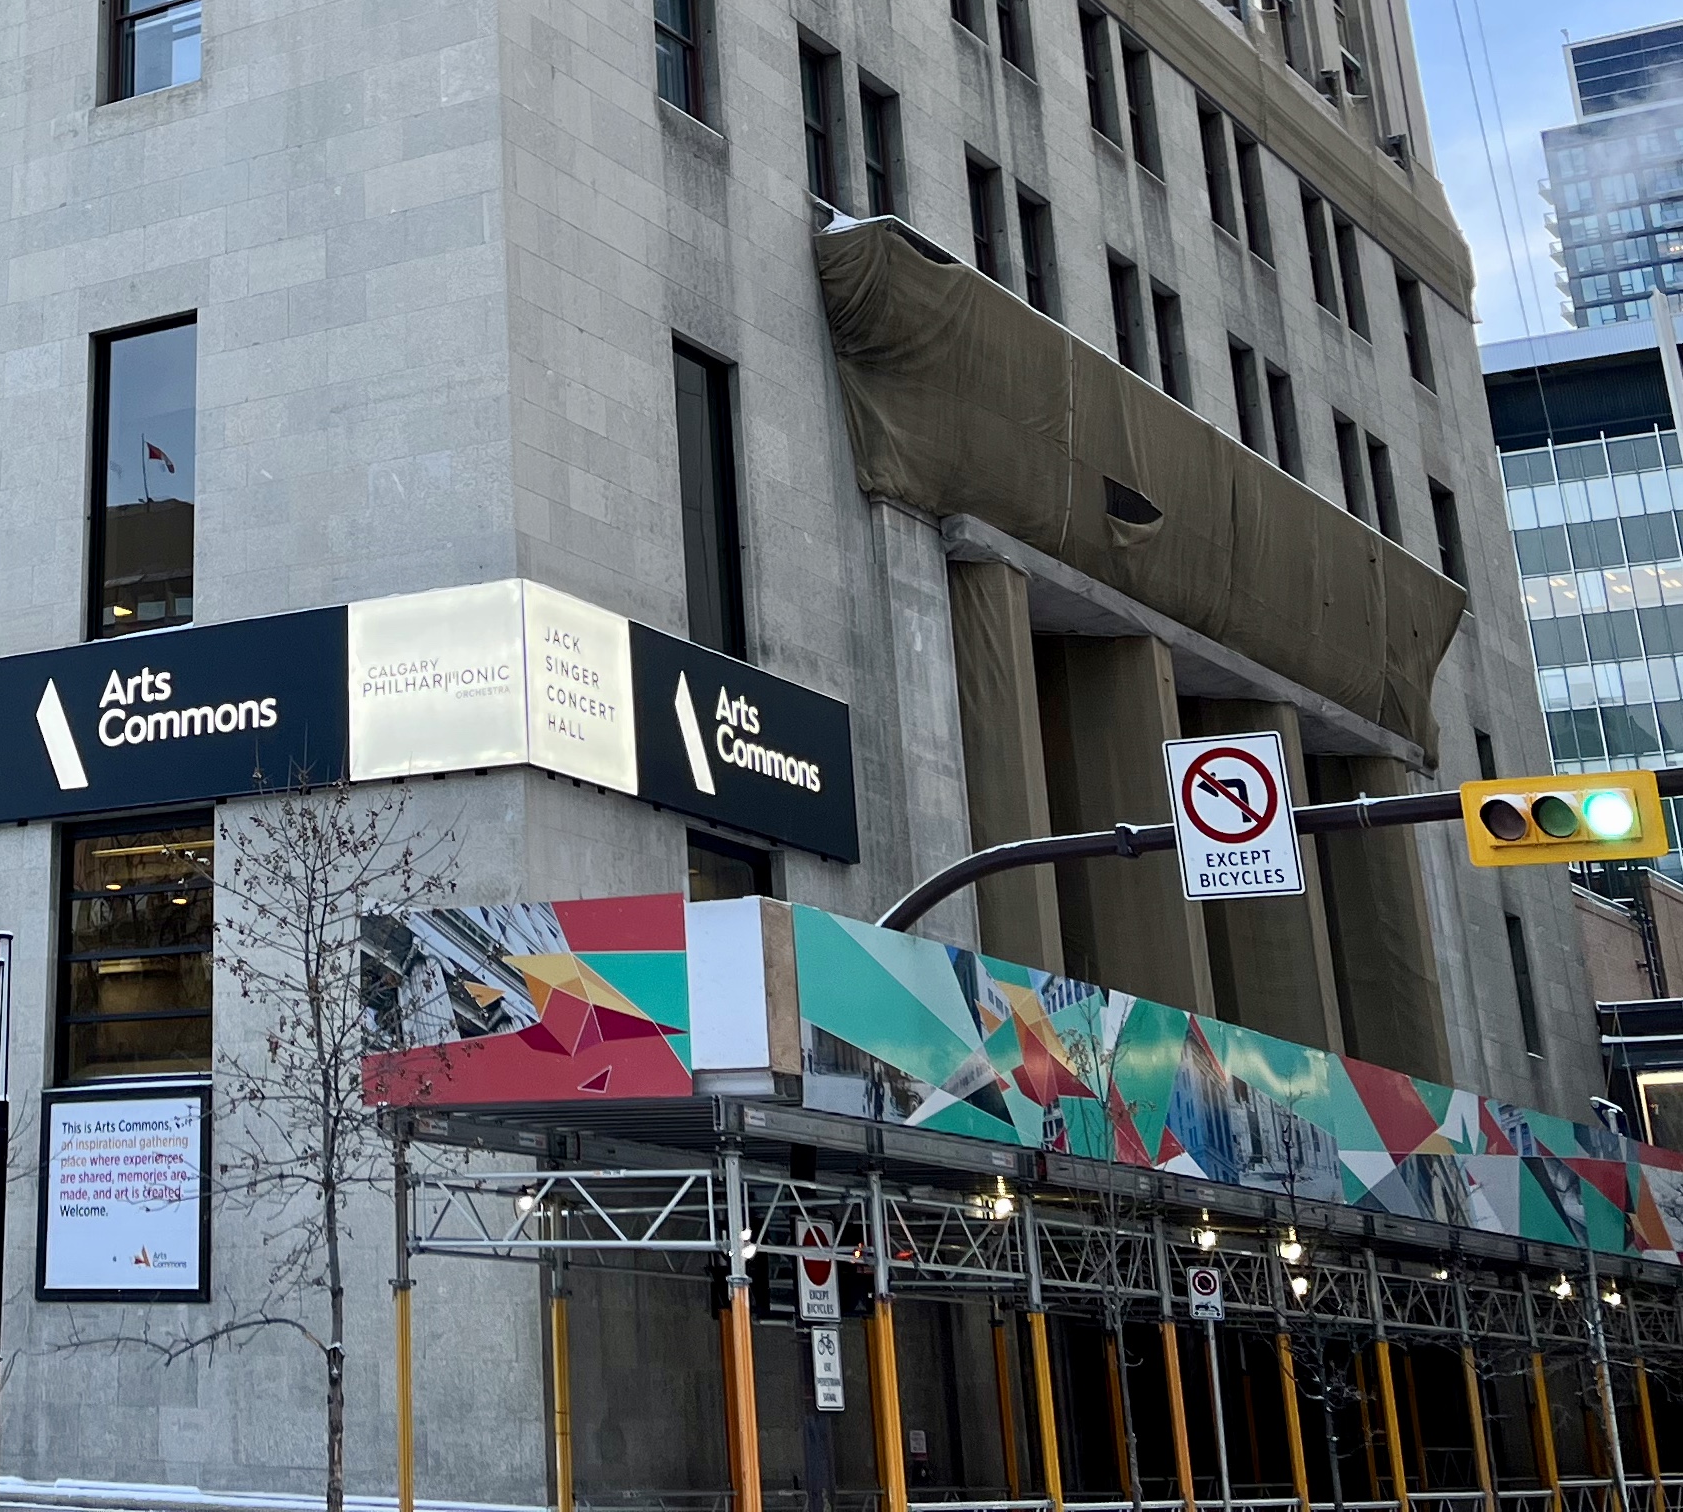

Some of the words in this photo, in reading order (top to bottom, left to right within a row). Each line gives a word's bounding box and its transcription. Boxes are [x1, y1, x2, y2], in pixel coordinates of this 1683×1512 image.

[543, 626, 581, 654] JACK
[367, 657, 440, 680] CALGARY
[545, 655, 600, 690] SINGER
[99, 666, 172, 708] Arts
[455, 685, 510, 700] ORCHESTRA
[546, 685, 615, 723] CONCERT
[716, 686, 760, 734] Arts
[98, 697, 277, 747] Commons
[548, 713, 585, 741] HALL
[717, 724, 820, 792] Commons
[1206, 849, 1270, 868] EXCEPT
[1199, 868, 1285, 888] BICYCLES
[62, 1121, 81, 1134] This
[84, 1121, 91, 1133] is
[94, 1120, 115, 1133] Arts
[118, 1119, 172, 1132] Commons,
[61, 1140, 73, 1151] an
[76, 1137, 136, 1152] inspirational
[139, 1134, 189, 1150] gathering
[61, 1155, 87, 1169] place
[90, 1152, 120, 1166] where
[123, 1153, 184, 1166] experiences
[60, 1174, 75, 1184] are
[78, 1169, 115, 1184] shared,
[118, 1170, 167, 1182] memories
[171, 1171, 187, 1181] are
[60, 1187, 90, 1201] made,
[93, 1186, 112, 1200] and
[115, 1188, 128, 1199] art
[132, 1186, 139, 1198] is
[60, 1205, 108, 1217] Welcome.
[153, 1251, 167, 1260] Arts
[153, 1261, 187, 1269] Commons
[809, 1289, 829, 1300] EXCEPT
[807, 1303, 834, 1315] BICYCLES
